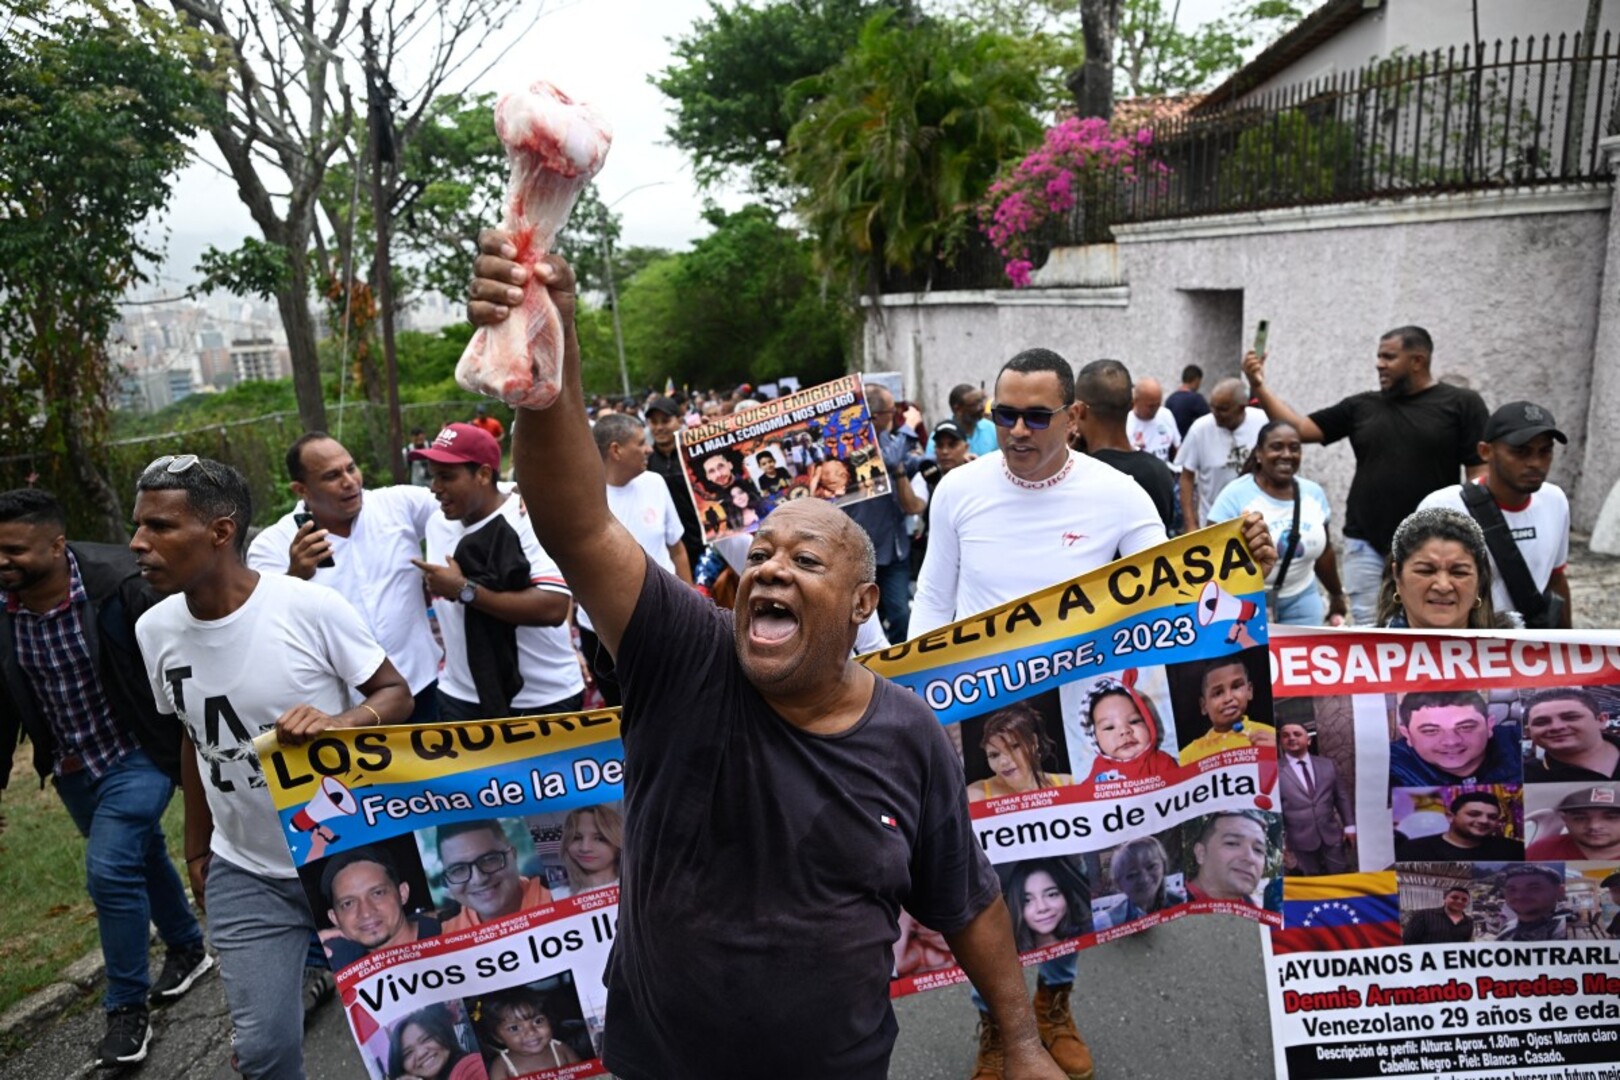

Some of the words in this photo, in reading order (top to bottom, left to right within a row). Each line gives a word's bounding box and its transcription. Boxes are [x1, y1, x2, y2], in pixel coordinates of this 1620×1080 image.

[683, 419, 731, 445] NADIE
[735, 404, 779, 428] QUISO
[783, 377, 854, 411] EMIGRAR
[688, 444, 704, 458] LA
[705, 433, 736, 452] MALA
[793, 406, 815, 422] NOS
[860, 606, 1042, 664] UELTA
[1058, 584, 1095, 620] A
[1108, 538, 1257, 605] CASA
[924, 640, 1104, 710] OCTUBRE,
[1113, 614, 1197, 655] 2023
[271, 732, 393, 790] LOS
[362, 789, 473, 827] Fecha
[479, 776, 525, 807] de
[530, 769, 567, 800] la
[572, 757, 625, 791] De
[1021, 790, 1059, 801] GUEVARA
[1093, 788, 1132, 799] GUEVARA
[1133, 780, 1166, 793] MORENO
[1094, 782, 1121, 792] EDWIN
[1123, 775, 1162, 788] EDUARDO
[1102, 805, 1146, 834] de
[572, 889, 615, 906] LEOMARLY
[581, 899, 607, 911] EDAD:
[474, 931, 498, 943] EDAD:
[475, 949, 520, 978] se
[528, 928, 583, 964] los
[592, 913, 619, 943] ll
[337, 959, 371, 983] ROSMER
[411, 939, 441, 953] PARRA
[358, 961, 385, 978] EDAD:
[934, 973, 945, 981] DE
[946, 970, 957, 978] LA
[1278, 952, 1413, 987] ¡AYUDANOS
[1420, 952, 1437, 971] A
[1444, 946, 1620, 970] ENCONTRARL
[1283, 987, 1362, 1014] Dennis
[1366, 979, 1472, 1008] Armando
[1476, 973, 1578, 1000] Paredes
[1582, 973, 1620, 1000] Me
[1303, 1013, 1435, 1038] Venezolano
[1440, 1006, 1469, 1029] 29
[1476, 1004, 1532, 1026] años
[1538, 1001, 1568, 1022] de
[1575, 1000, 1620, 1020] eda
[1316, 1044, 1374, 1062] Descripción
[1376, 1043, 1388, 1057] de
[1390, 1041, 1419, 1059] perfil:
[1421, 1039, 1453, 1053] Altura:
[1454, 1037, 1487, 1053] Aprox.
[1488, 1034, 1519, 1049] 1.80m
[1526, 1032, 1552, 1049] Ojos:
[1554, 1028, 1590, 1045] Marrón
[1592, 1026, 1618, 1042] claro
[1380, 1058, 1419, 1073] Cabello:
[1421, 1056, 1451, 1073] Negro
[1458, 1053, 1481, 1069] Piel:
[1482, 1051, 1517, 1067] Blanca
[1524, 1049, 1565, 1064] Casado.
